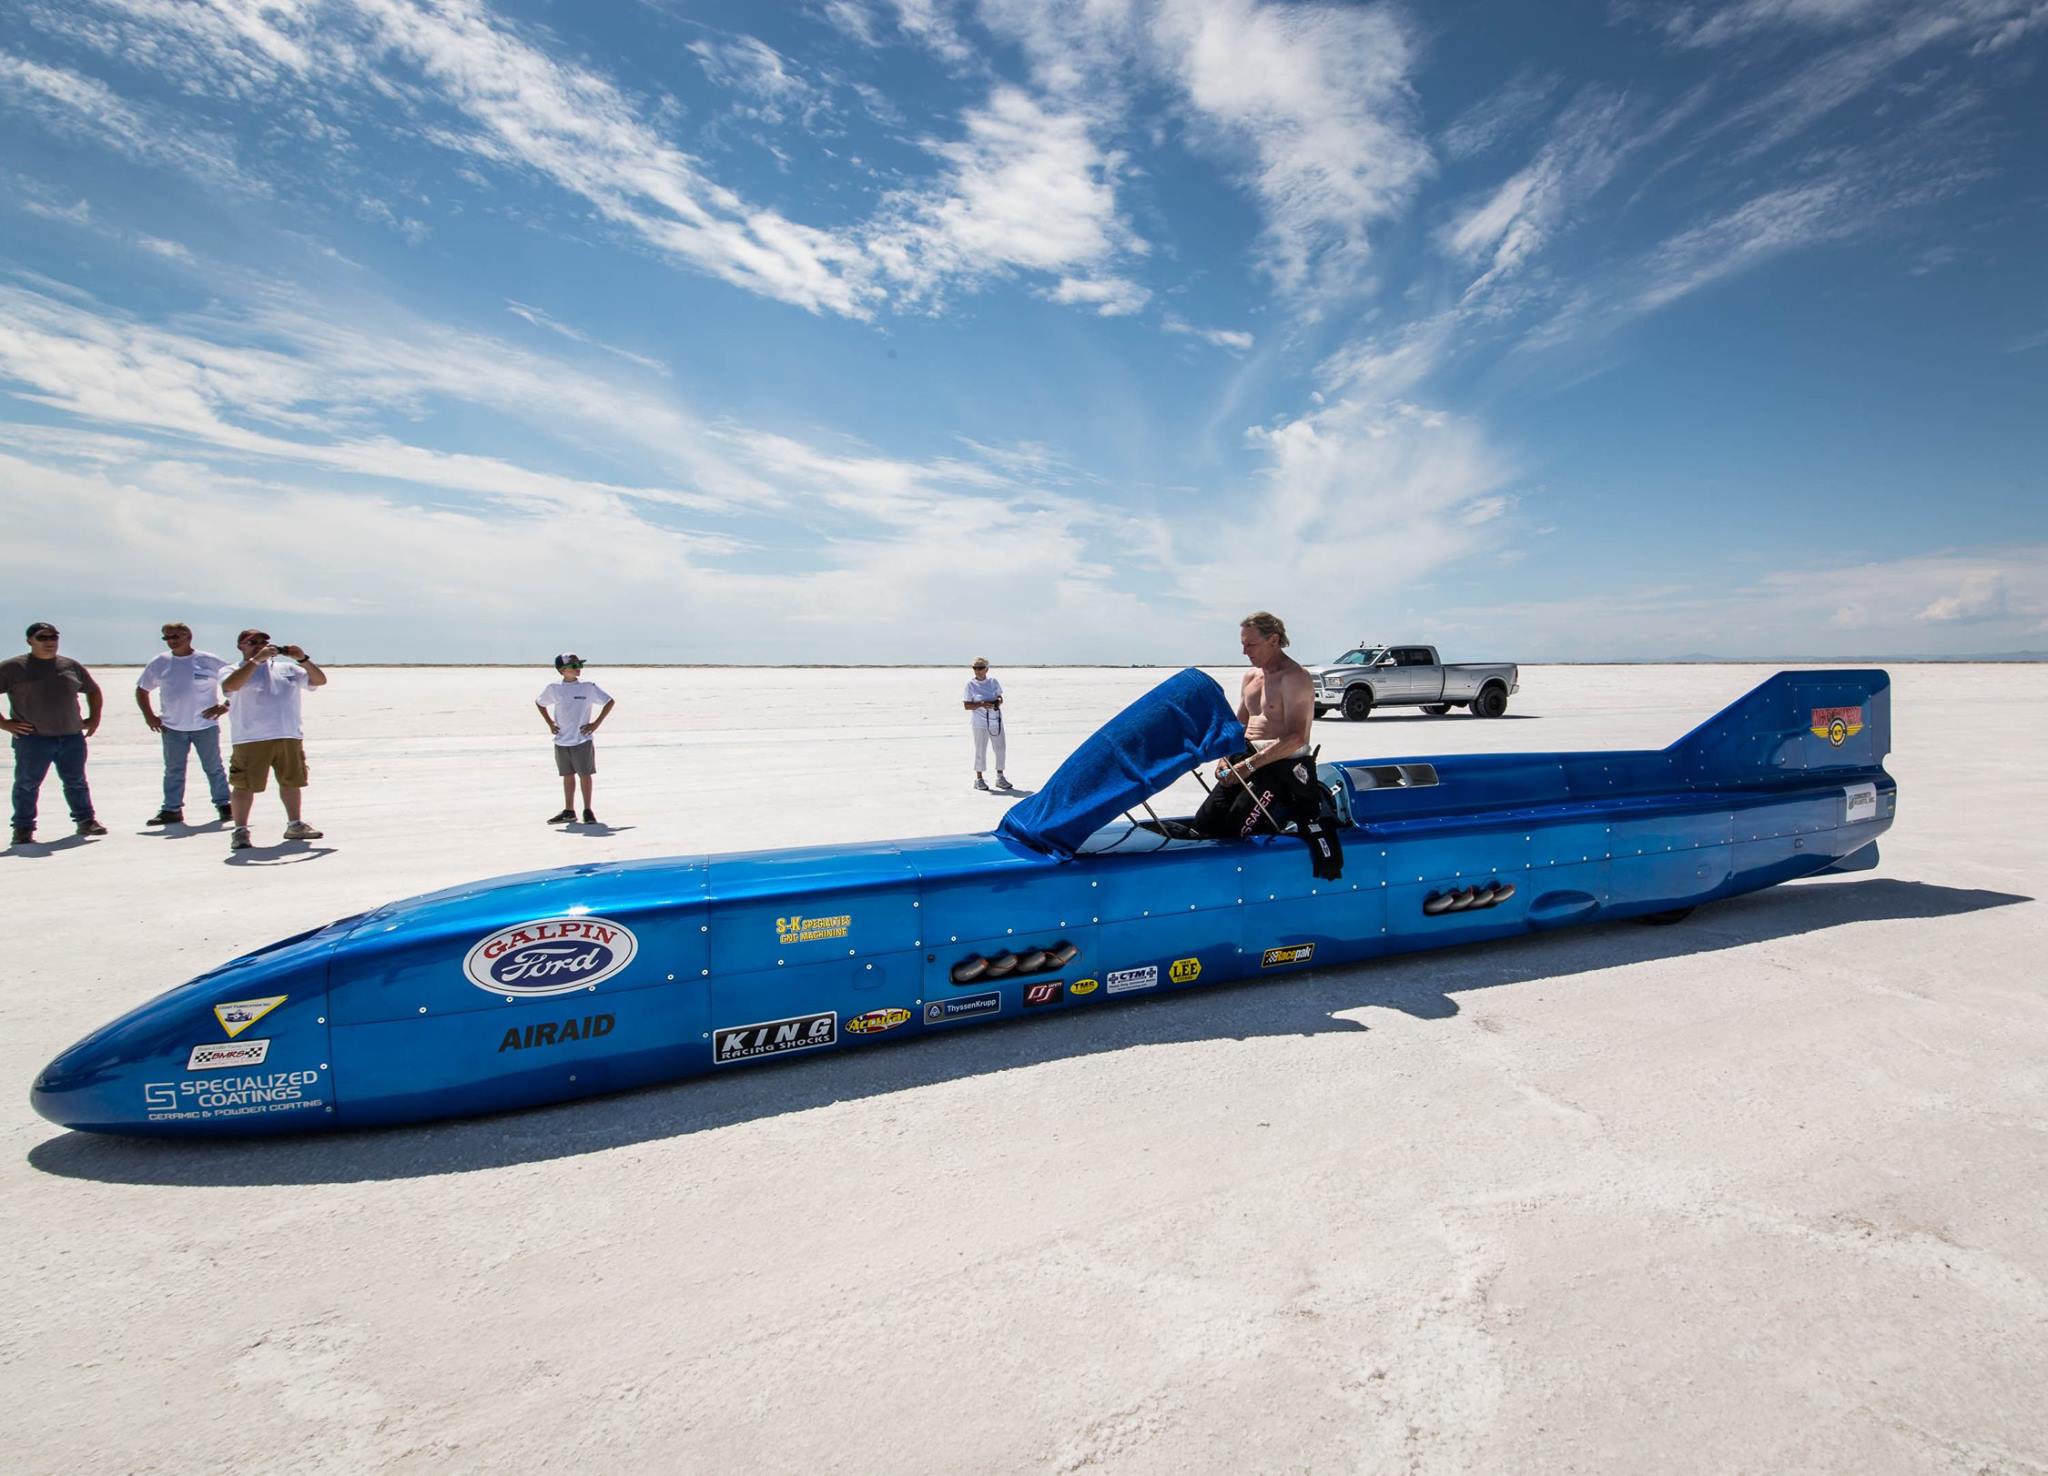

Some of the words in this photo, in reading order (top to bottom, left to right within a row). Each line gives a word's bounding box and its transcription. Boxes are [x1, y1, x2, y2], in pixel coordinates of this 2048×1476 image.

[484, 923, 618, 959] GALPIN
[501, 948, 601, 982] Ford
[1119, 969, 1147, 980] CTM
[1173, 963, 1198, 978] LEE
[1074, 981, 1095, 990] TMS
[947, 999, 997, 1012] ThyssenKrupp
[498, 1013, 617, 1053] AIRAID
[722, 1018, 832, 1052] KING
[212, 1050, 245, 1059] BMRS
[722, 1045, 775, 1059] RACING
[779, 1035, 830, 1049] SHOCKS
[180, 1070, 318, 1095] SPECIALIZED
[199, 1086, 302, 1107] COATINGS
[149, 1111, 200, 1121] CERAMIC
[215, 1105, 266, 1117] POWDER
[269, 1099, 322, 1112] COATING
